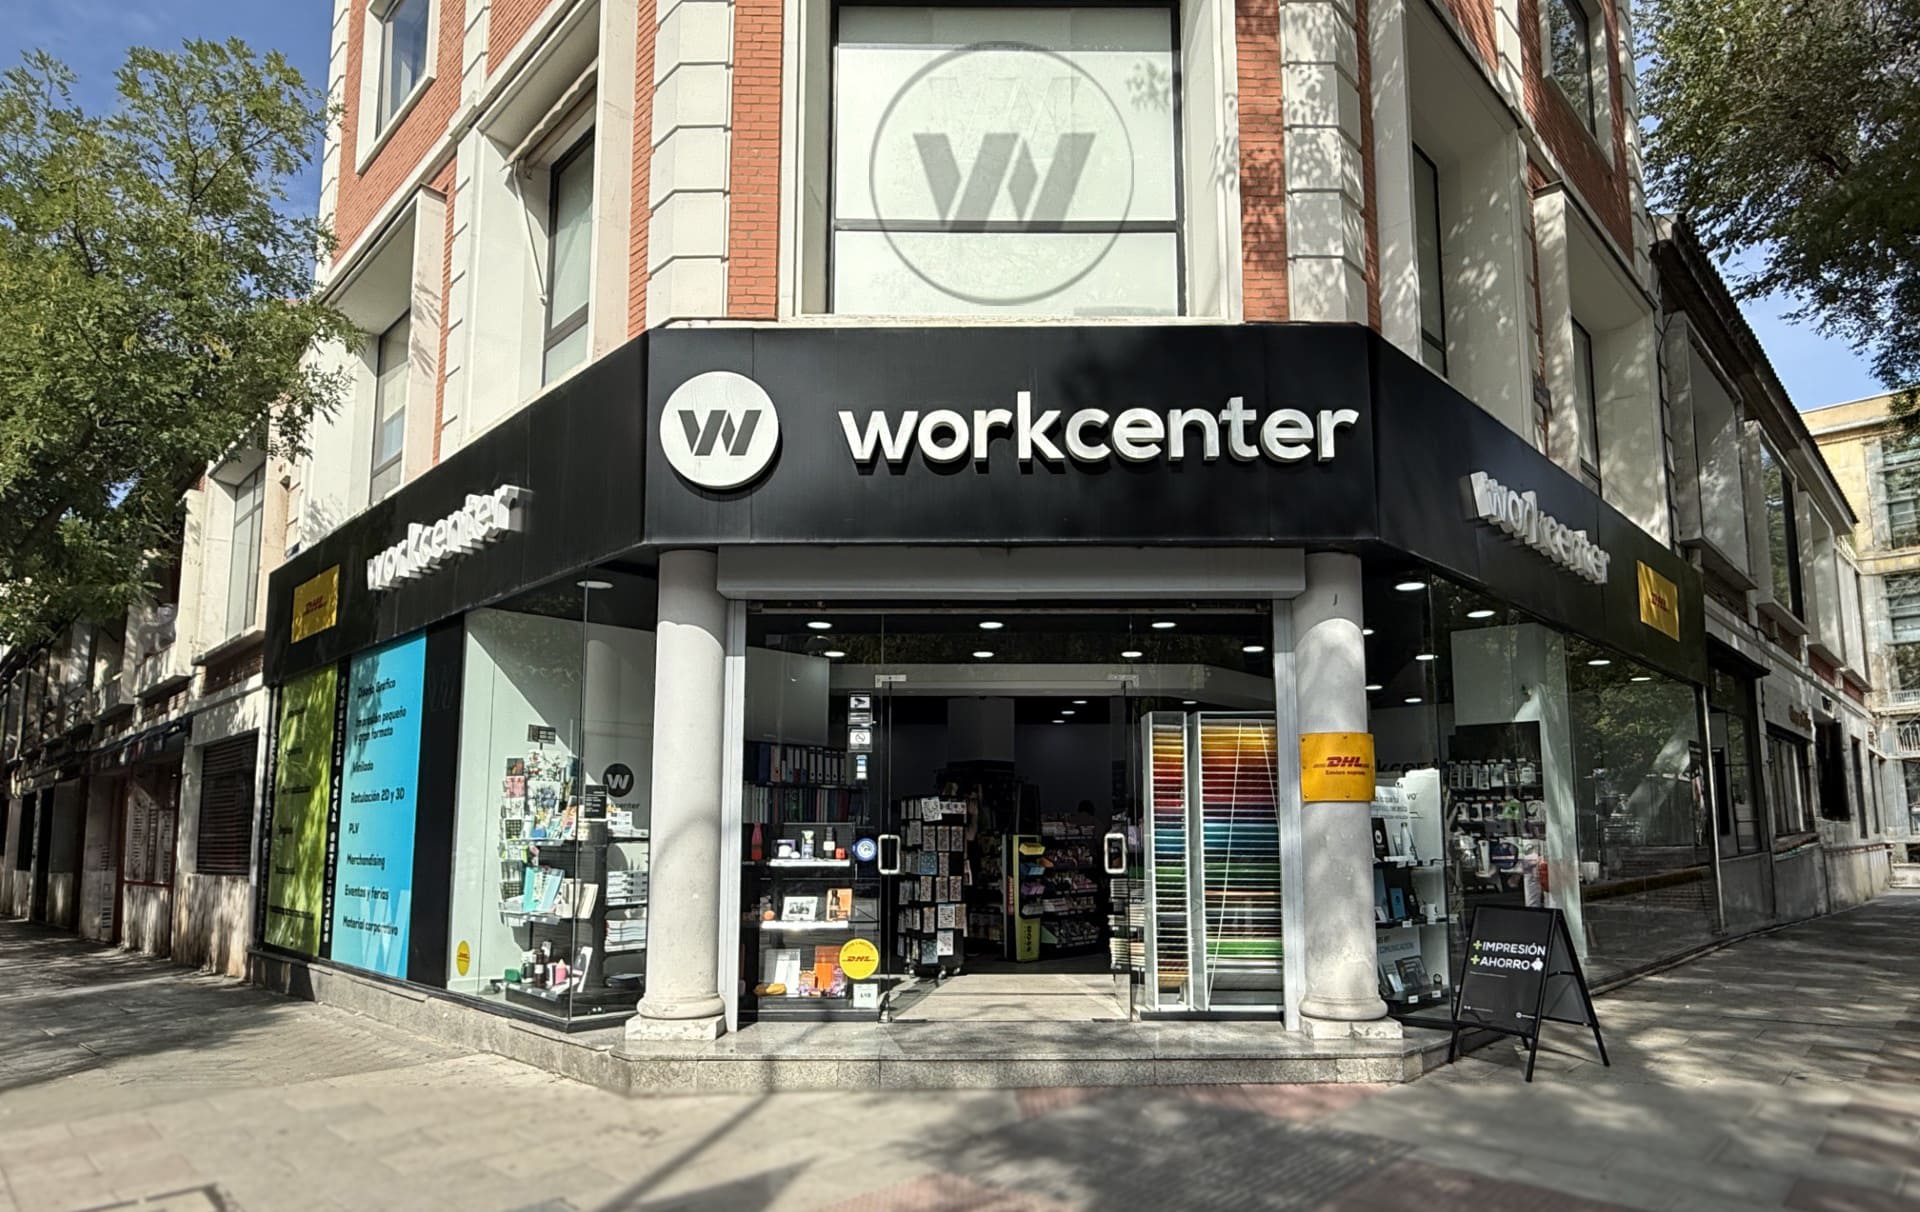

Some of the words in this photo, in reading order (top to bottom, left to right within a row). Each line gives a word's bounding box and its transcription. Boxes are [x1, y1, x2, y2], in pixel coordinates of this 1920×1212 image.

[838, 391, 1359, 463] workcenter
[1326, 756, 1362, 768] DHL
[381, 788, 390, 802] 2D
[395, 787, 406, 801] 3D
[348, 823, 360, 835] PLV
[346, 853, 386, 871] Merchandising
[345, 884, 366, 899] Eventos
[371, 886, 389, 901] ferias
